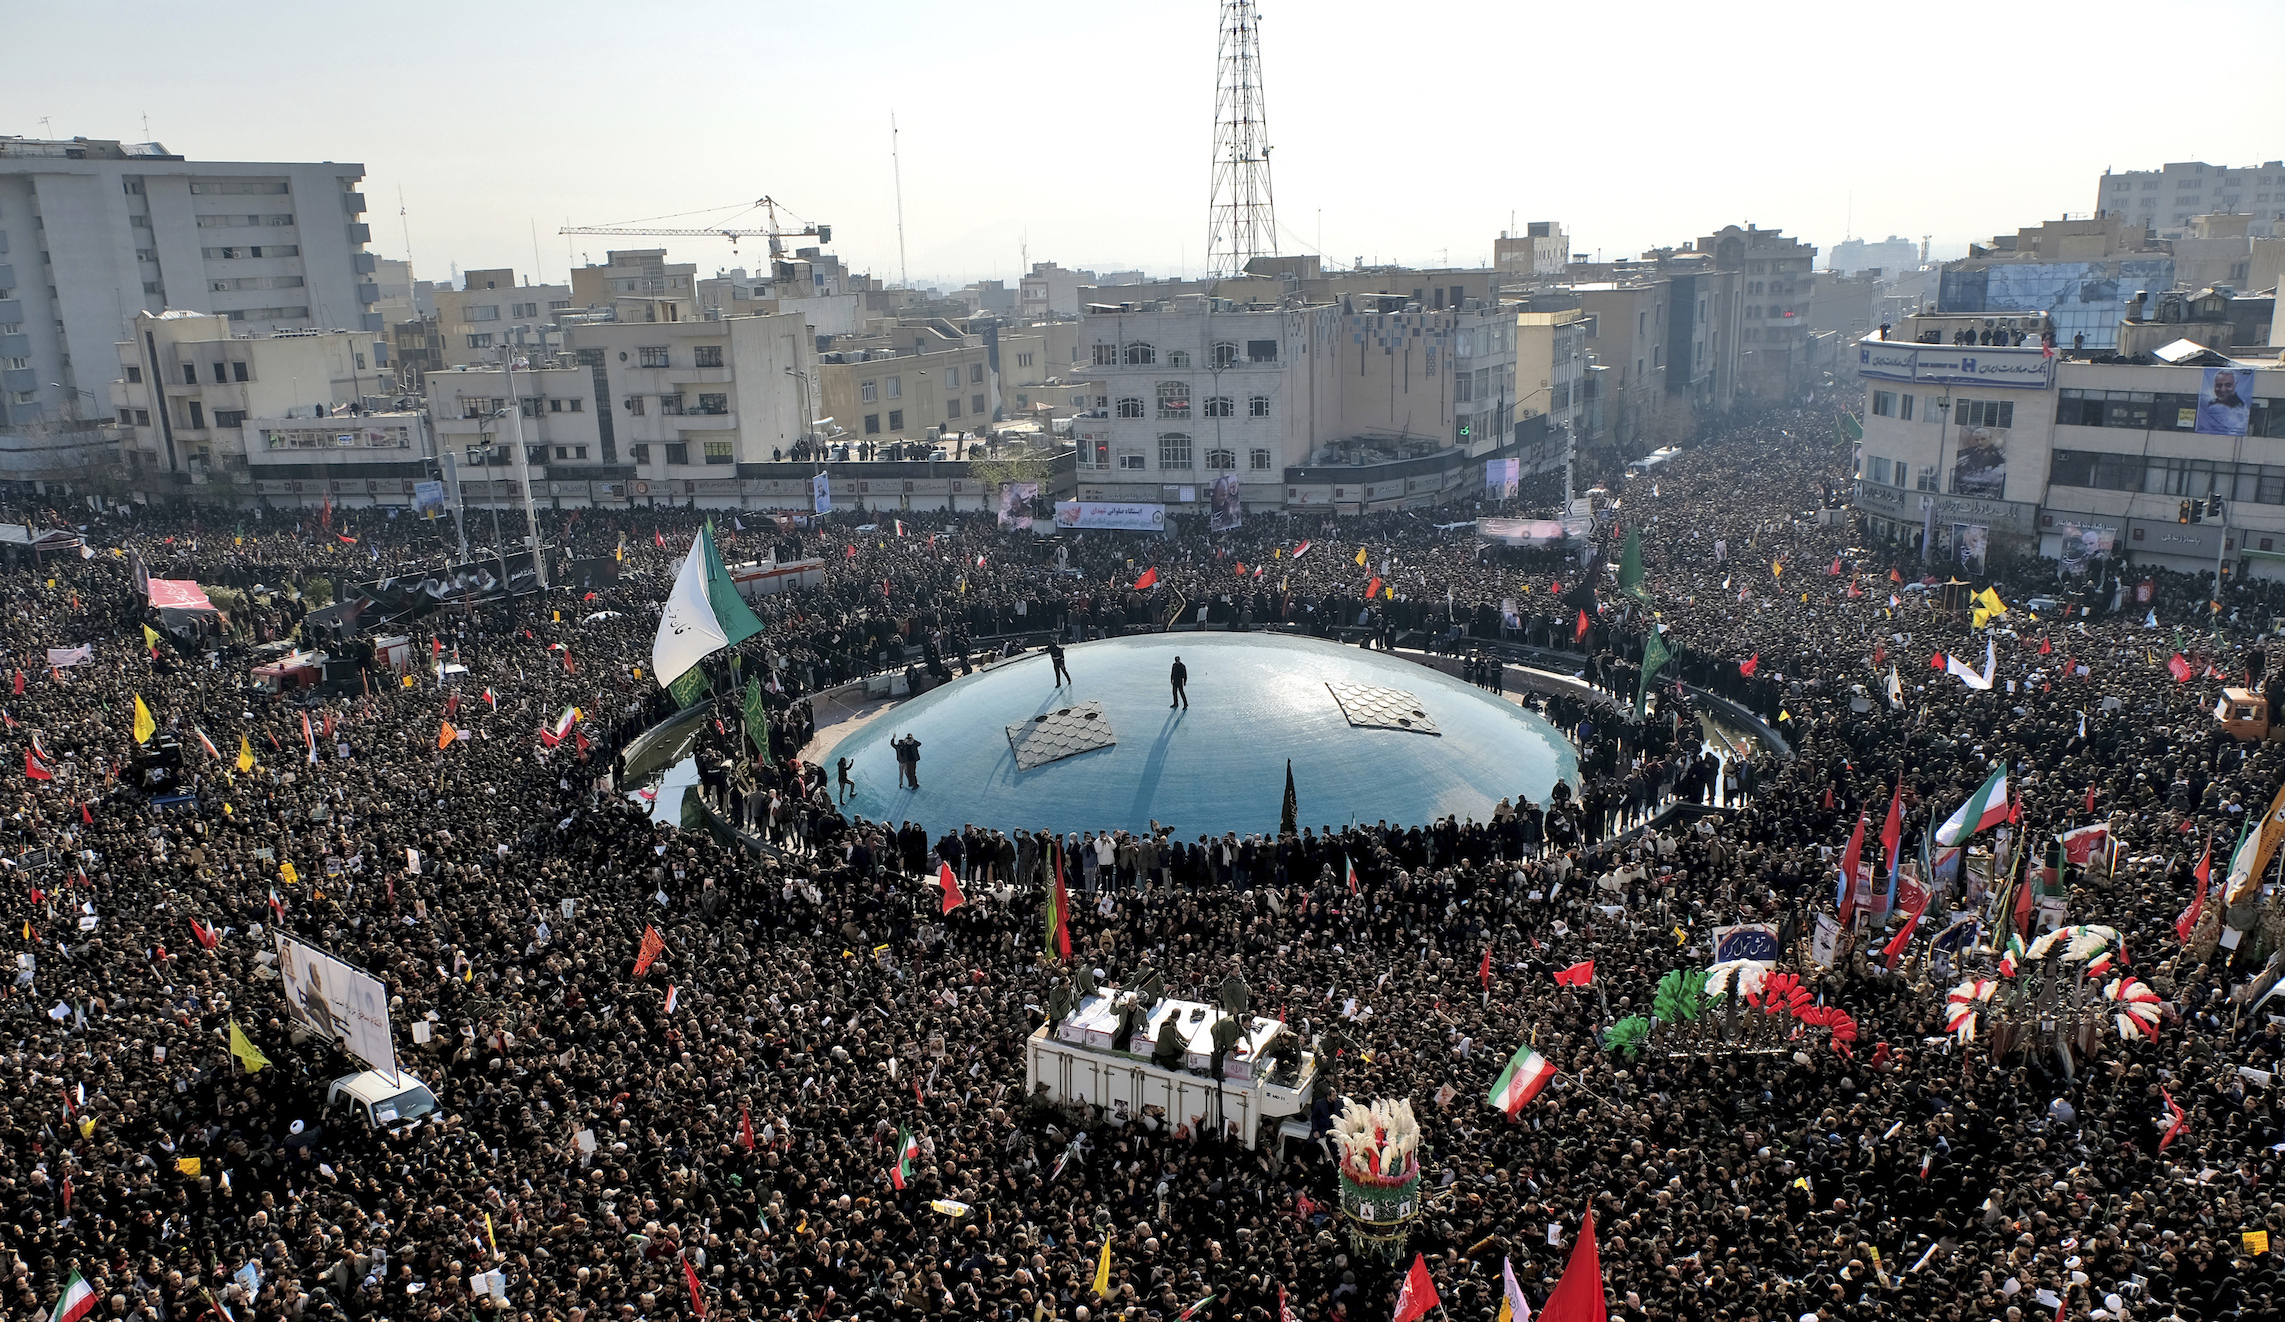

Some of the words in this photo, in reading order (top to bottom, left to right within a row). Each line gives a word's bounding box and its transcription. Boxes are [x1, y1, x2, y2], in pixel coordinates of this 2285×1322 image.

[1978, 364, 1999, 374] ایران
[1998, 364, 2028, 373] صادرات
[2028, 361, 2048, 377] بانک
[1107, 507, 1125, 516] صلواتی
[1125, 507, 1142, 517] ایستگاه
[1937, 501, 1961, 513] ایران
[1960, 502, 1995, 514] صادرات
[1995, 503, 2019, 521] بانک
[2161, 533, 2183, 543] زندگی
[2182, 534, 2201, 546] پاساژ
[1733, 935, 1751, 957] تحول
[1749, 936, 1770, 955] ارتش
